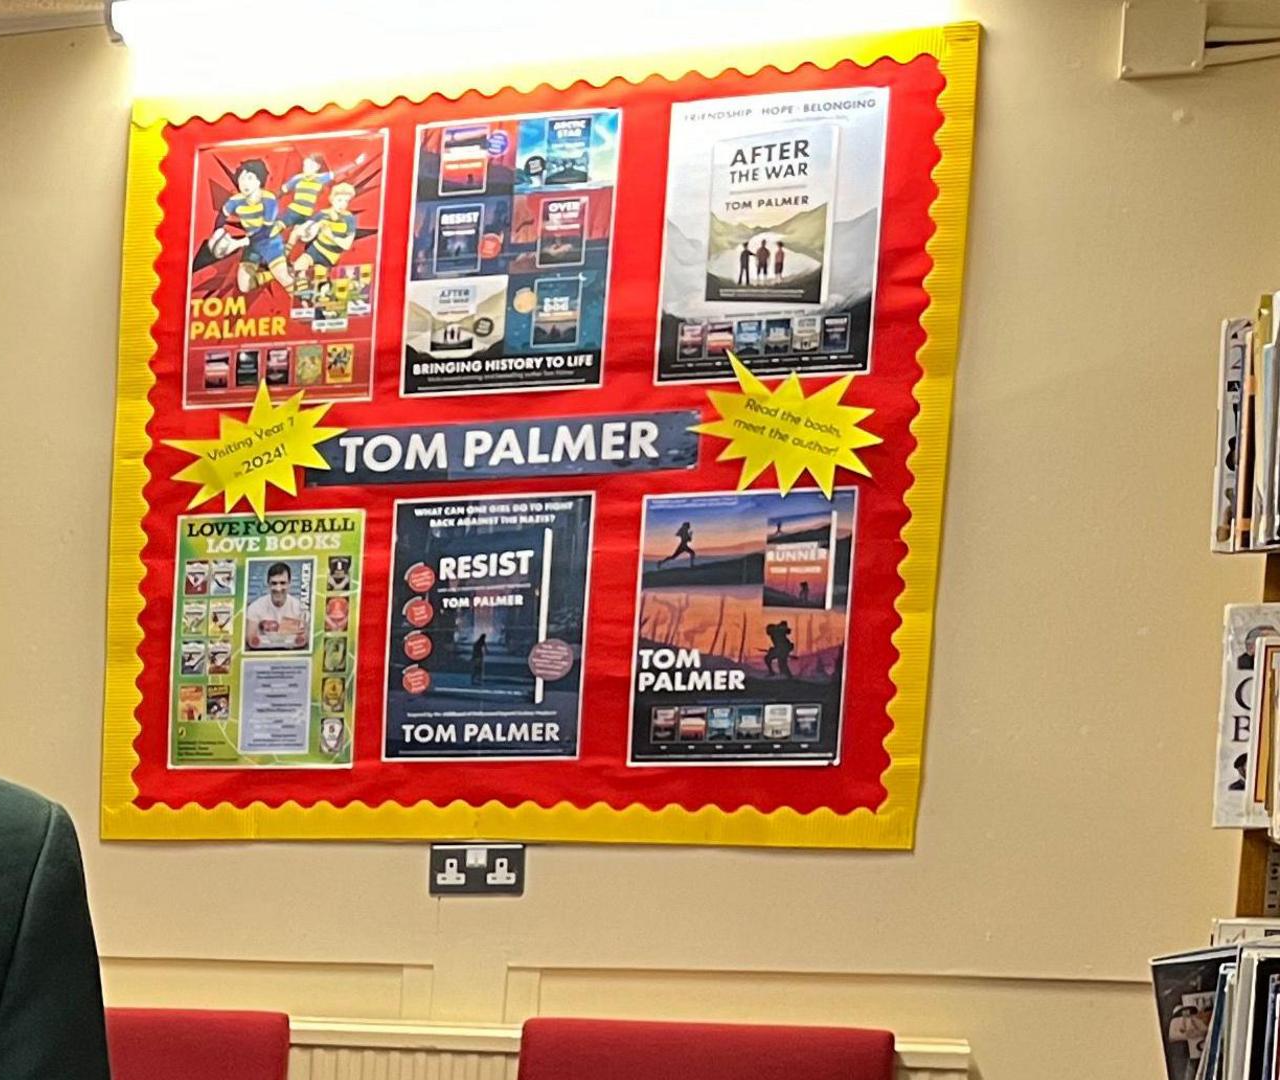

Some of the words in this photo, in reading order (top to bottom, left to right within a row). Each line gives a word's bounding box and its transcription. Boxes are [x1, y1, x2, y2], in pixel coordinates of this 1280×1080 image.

[684, 108, 753, 121] FRIENDSHIP
[761, 105, 795, 116] HOPE
[803, 98, 877, 113] BELONGING
[729, 139, 810, 167] AFTER
[730, 166, 760, 184] THE
[765, 162, 808, 179] WAR
[726, 198, 753, 211] TOM
[757, 195, 810, 209] PALMER
[190, 296, 247, 317] TOM
[190, 316, 287, 340] PALMER
[412, 359, 482, 376] BRINGING
[485, 356, 545, 371] HISTORY
[546, 356, 563, 368] TO
[566, 354, 594, 367] LIFE
[207, 436, 254, 462] Visiting
[253, 421, 285, 442] Year
[287, 416, 295, 427] 7
[732, 417, 767, 435] meet
[767, 426, 789, 443] the
[339, 431, 448, 474] TOM
[463, 420, 660, 468] PALMER
[414, 506, 443, 517] WHAT
[443, 505, 465, 516] CAN
[466, 504, 487, 515] ONE
[488, 503, 512, 514] GIRL
[512, 502, 528, 513] DO
[528, 502, 543, 512] TO
[544, 501, 574, 512] FIGHT
[187, 522, 239, 538] LOVE
[243, 517, 355, 536] FOOTBALL
[429, 518, 455, 528] BACK
[456, 516, 498, 527] AGAINST
[500, 515, 518, 525] THE
[519, 514, 556, 525] NAZIS?
[206, 536, 260, 553] LOVE
[265, 533, 342, 551] BOOKS
[439, 550, 534, 581] RESIST
[766, 549, 828, 562] RUNNER
[442, 596, 470, 609] TOM
[473, 594, 524, 608] PALMER
[638, 648, 701, 670] TOM
[638, 670, 746, 692] PALMER
[401, 723, 457, 744] TOM
[464, 721, 560, 743] PALMER
